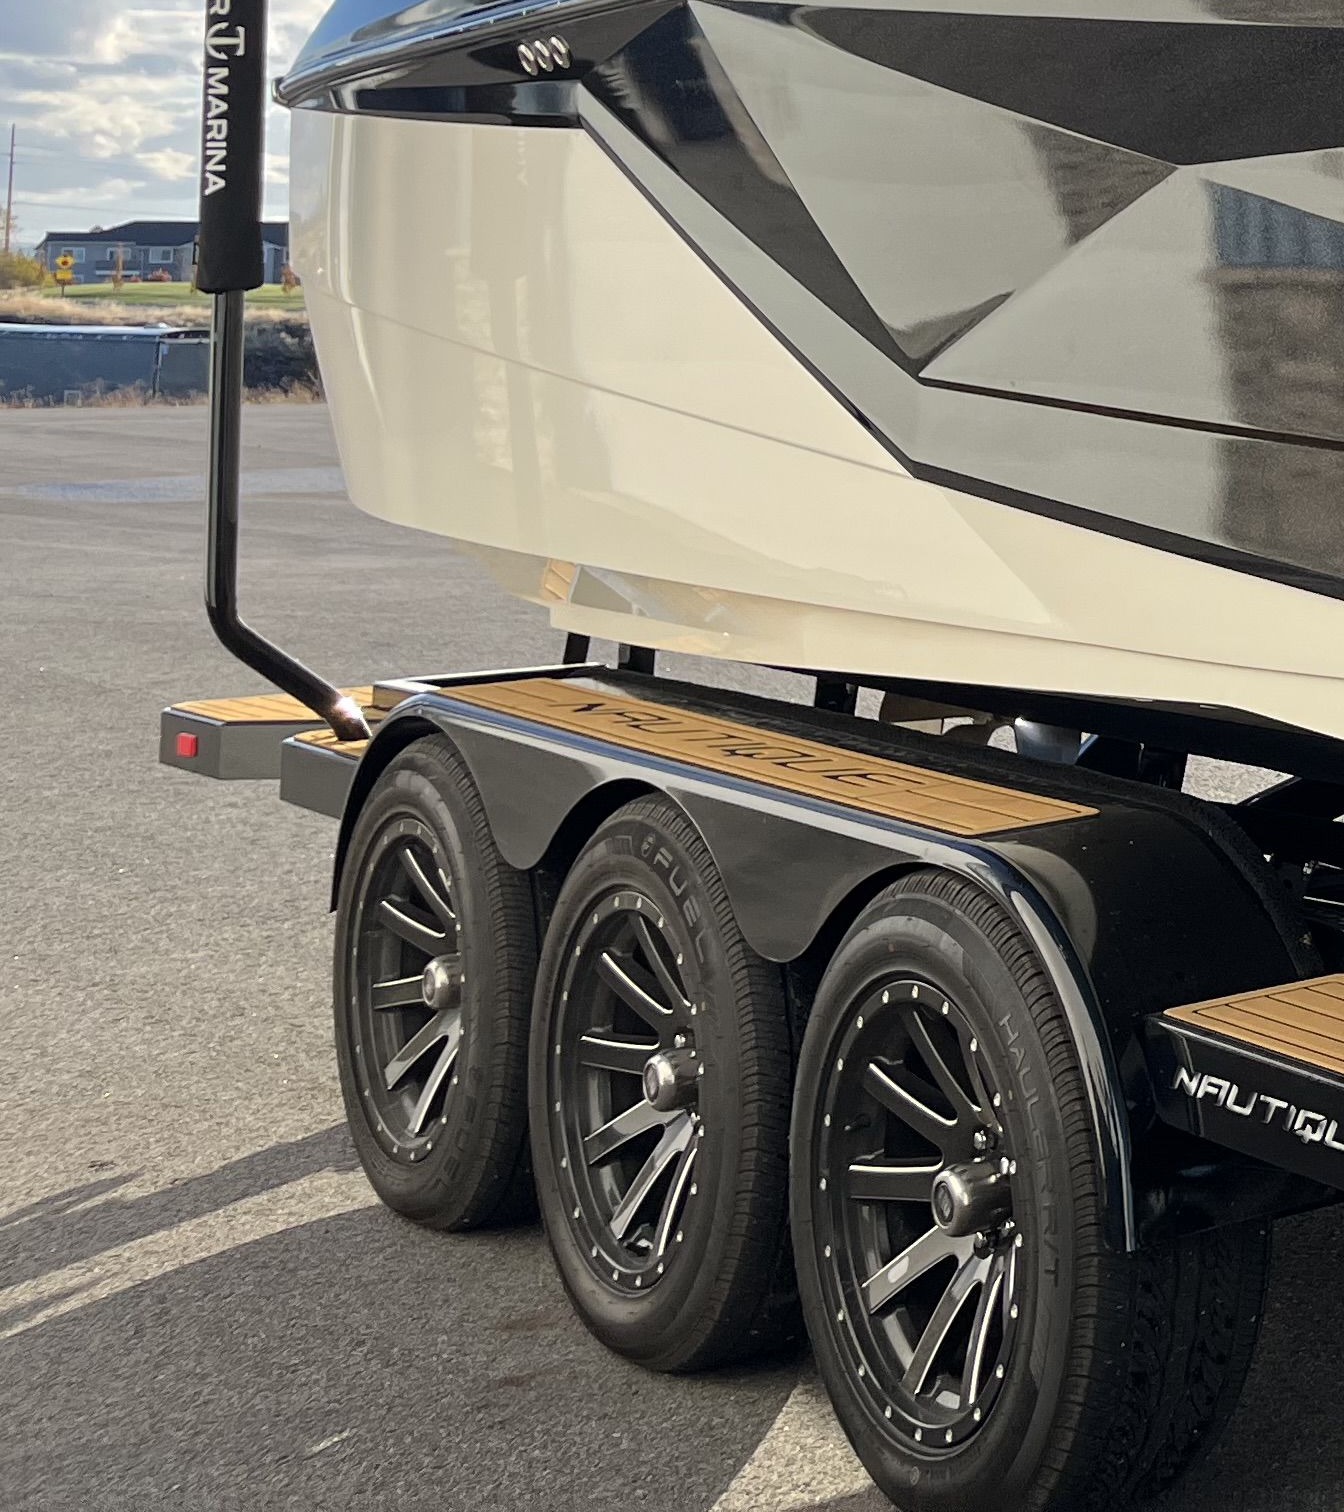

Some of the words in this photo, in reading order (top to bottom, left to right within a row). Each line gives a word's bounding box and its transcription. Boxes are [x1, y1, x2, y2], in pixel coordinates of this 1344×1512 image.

[203, 66, 230, 196] MARINA
[548, 702, 926, 788] NAUTIQUE
[653, 846, 708, 964] FUEL
